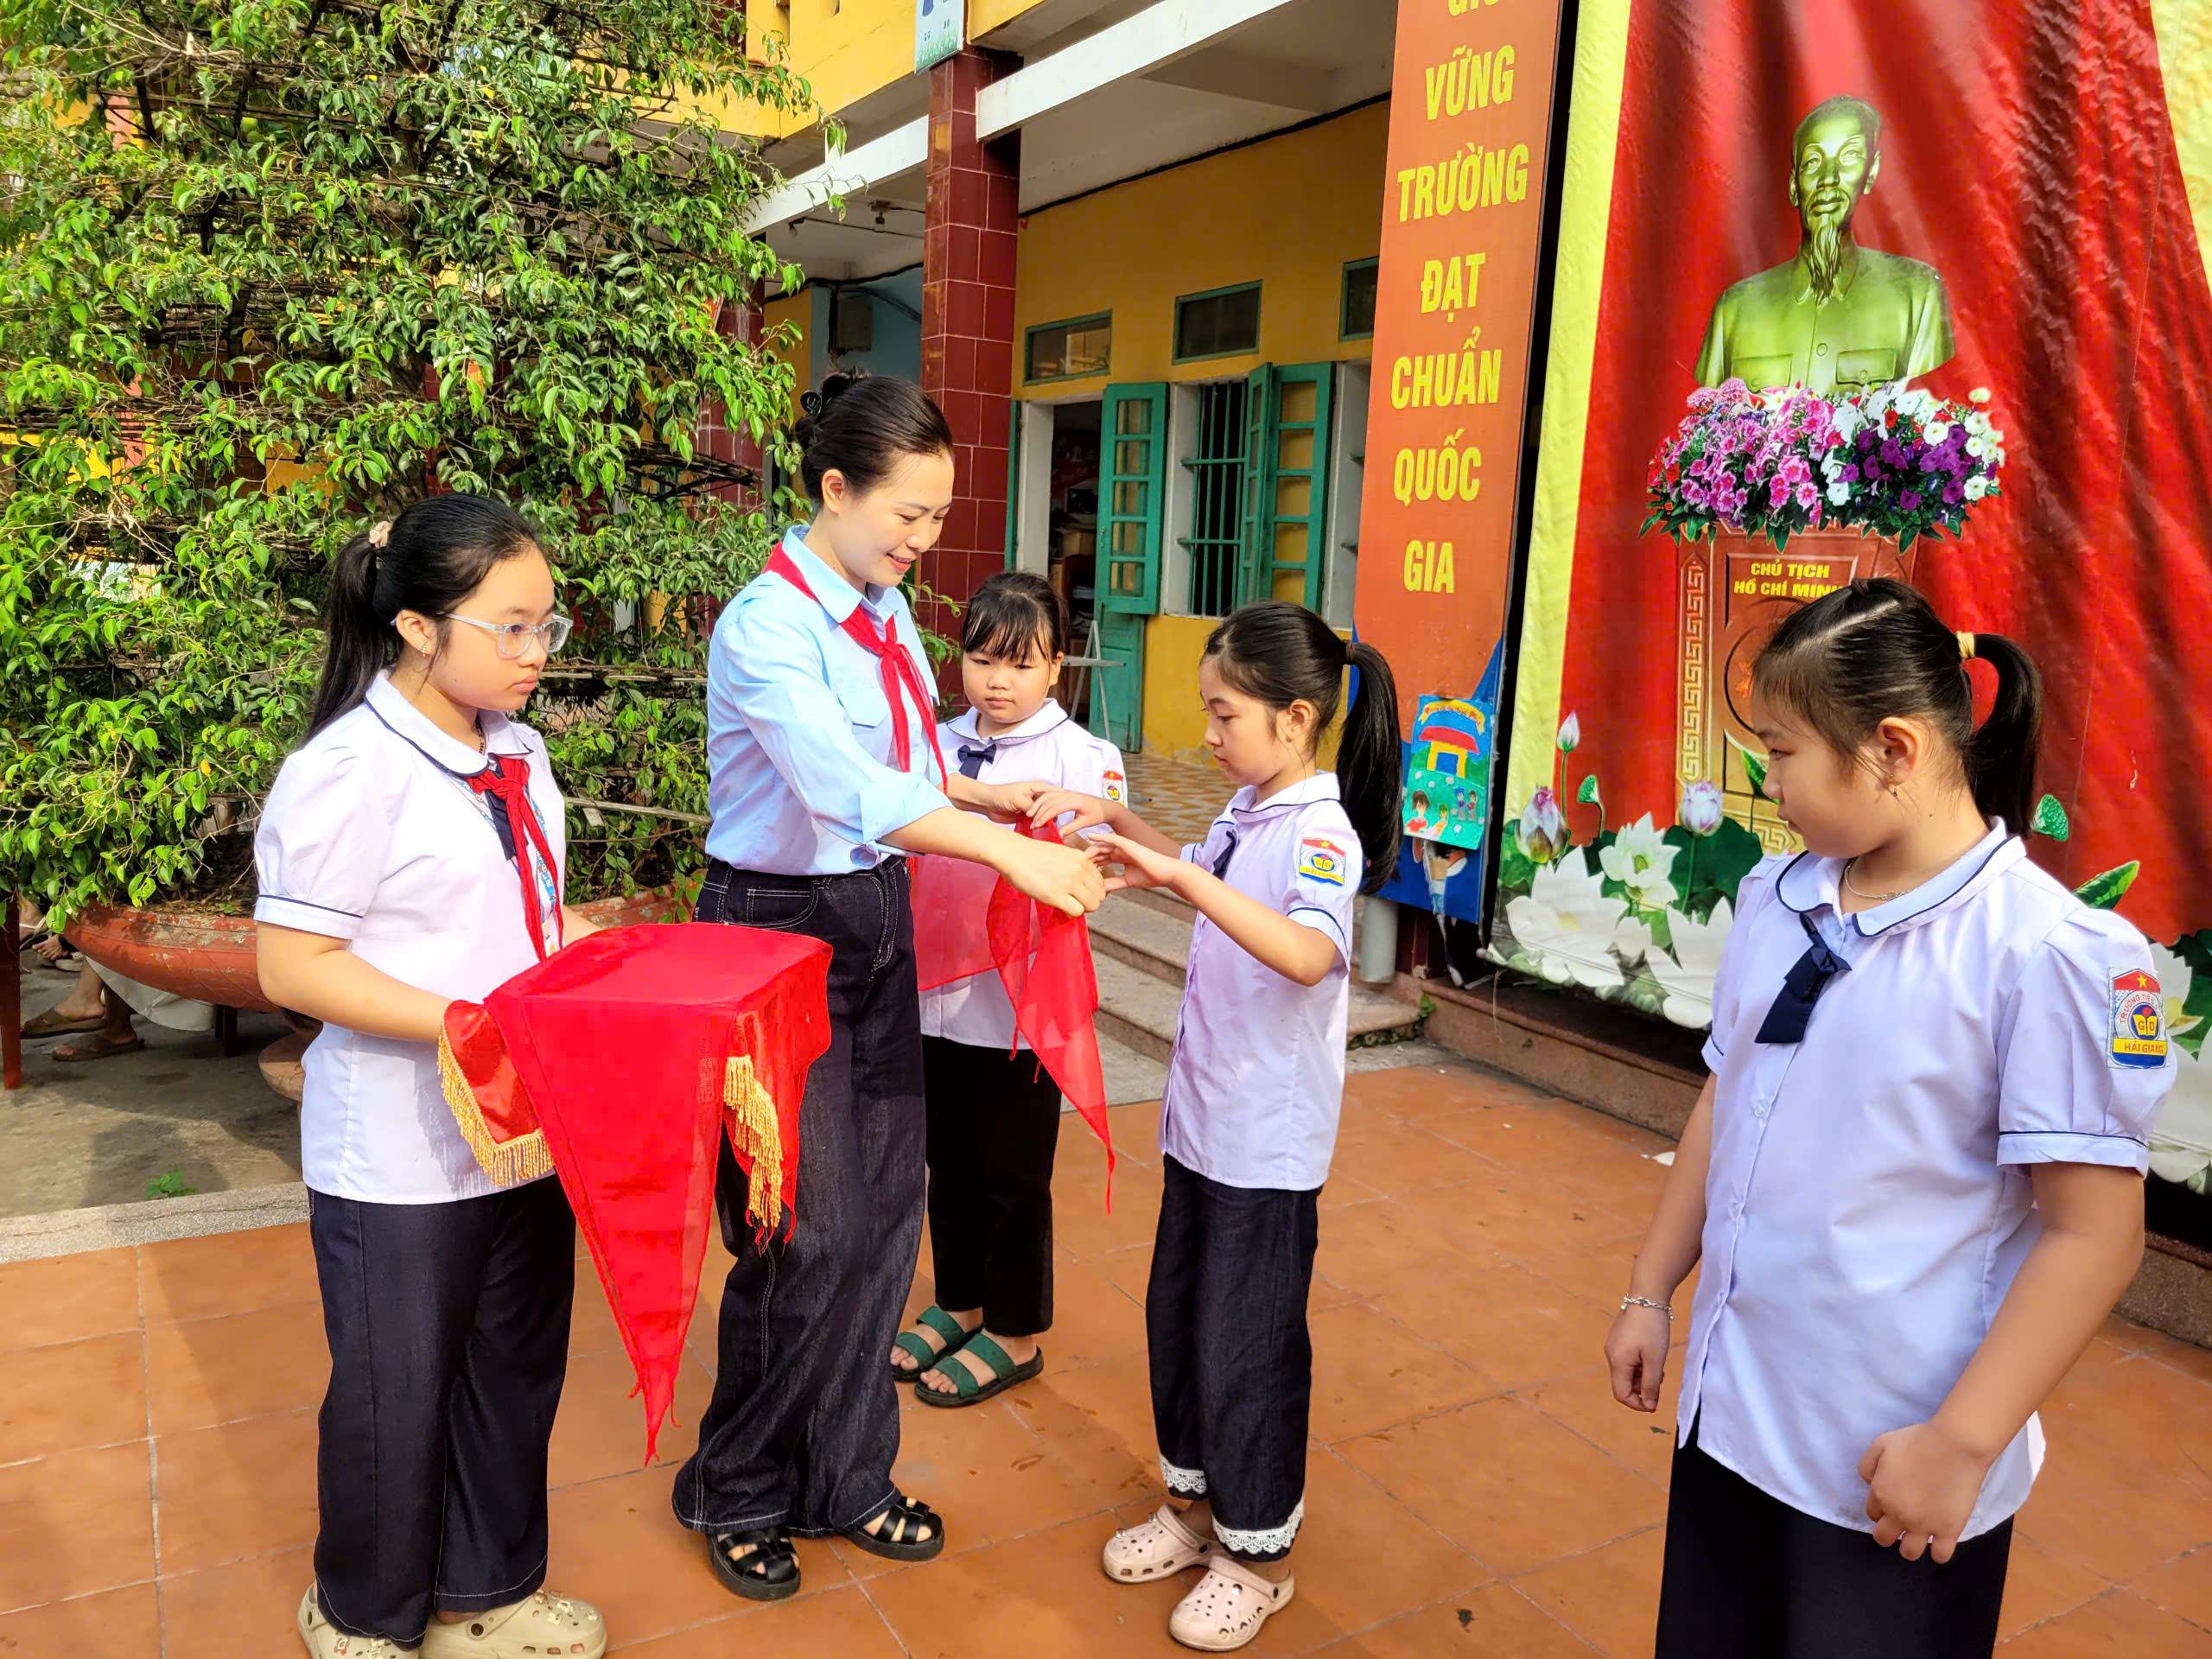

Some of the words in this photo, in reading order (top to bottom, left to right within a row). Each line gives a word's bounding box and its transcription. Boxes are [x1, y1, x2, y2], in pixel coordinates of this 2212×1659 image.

[1426, 45, 1515, 120] VỮNG
[1396, 142, 1529, 222] TRƯỜNG
[1421, 252, 1486, 323] ĐẠT
[1391, 325, 1502, 410] CHUẨN
[1394, 429, 1482, 506] QUỐC
[1403, 539, 1454, 594] GIA
[1733, 578, 1757, 594] HỒ
[1760, 581, 1788, 596] CHÍ
[1791, 583, 1842, 598] MIN
[1751, 559, 1783, 576] CHỦ
[1788, 563, 1830, 580] TỊCH
